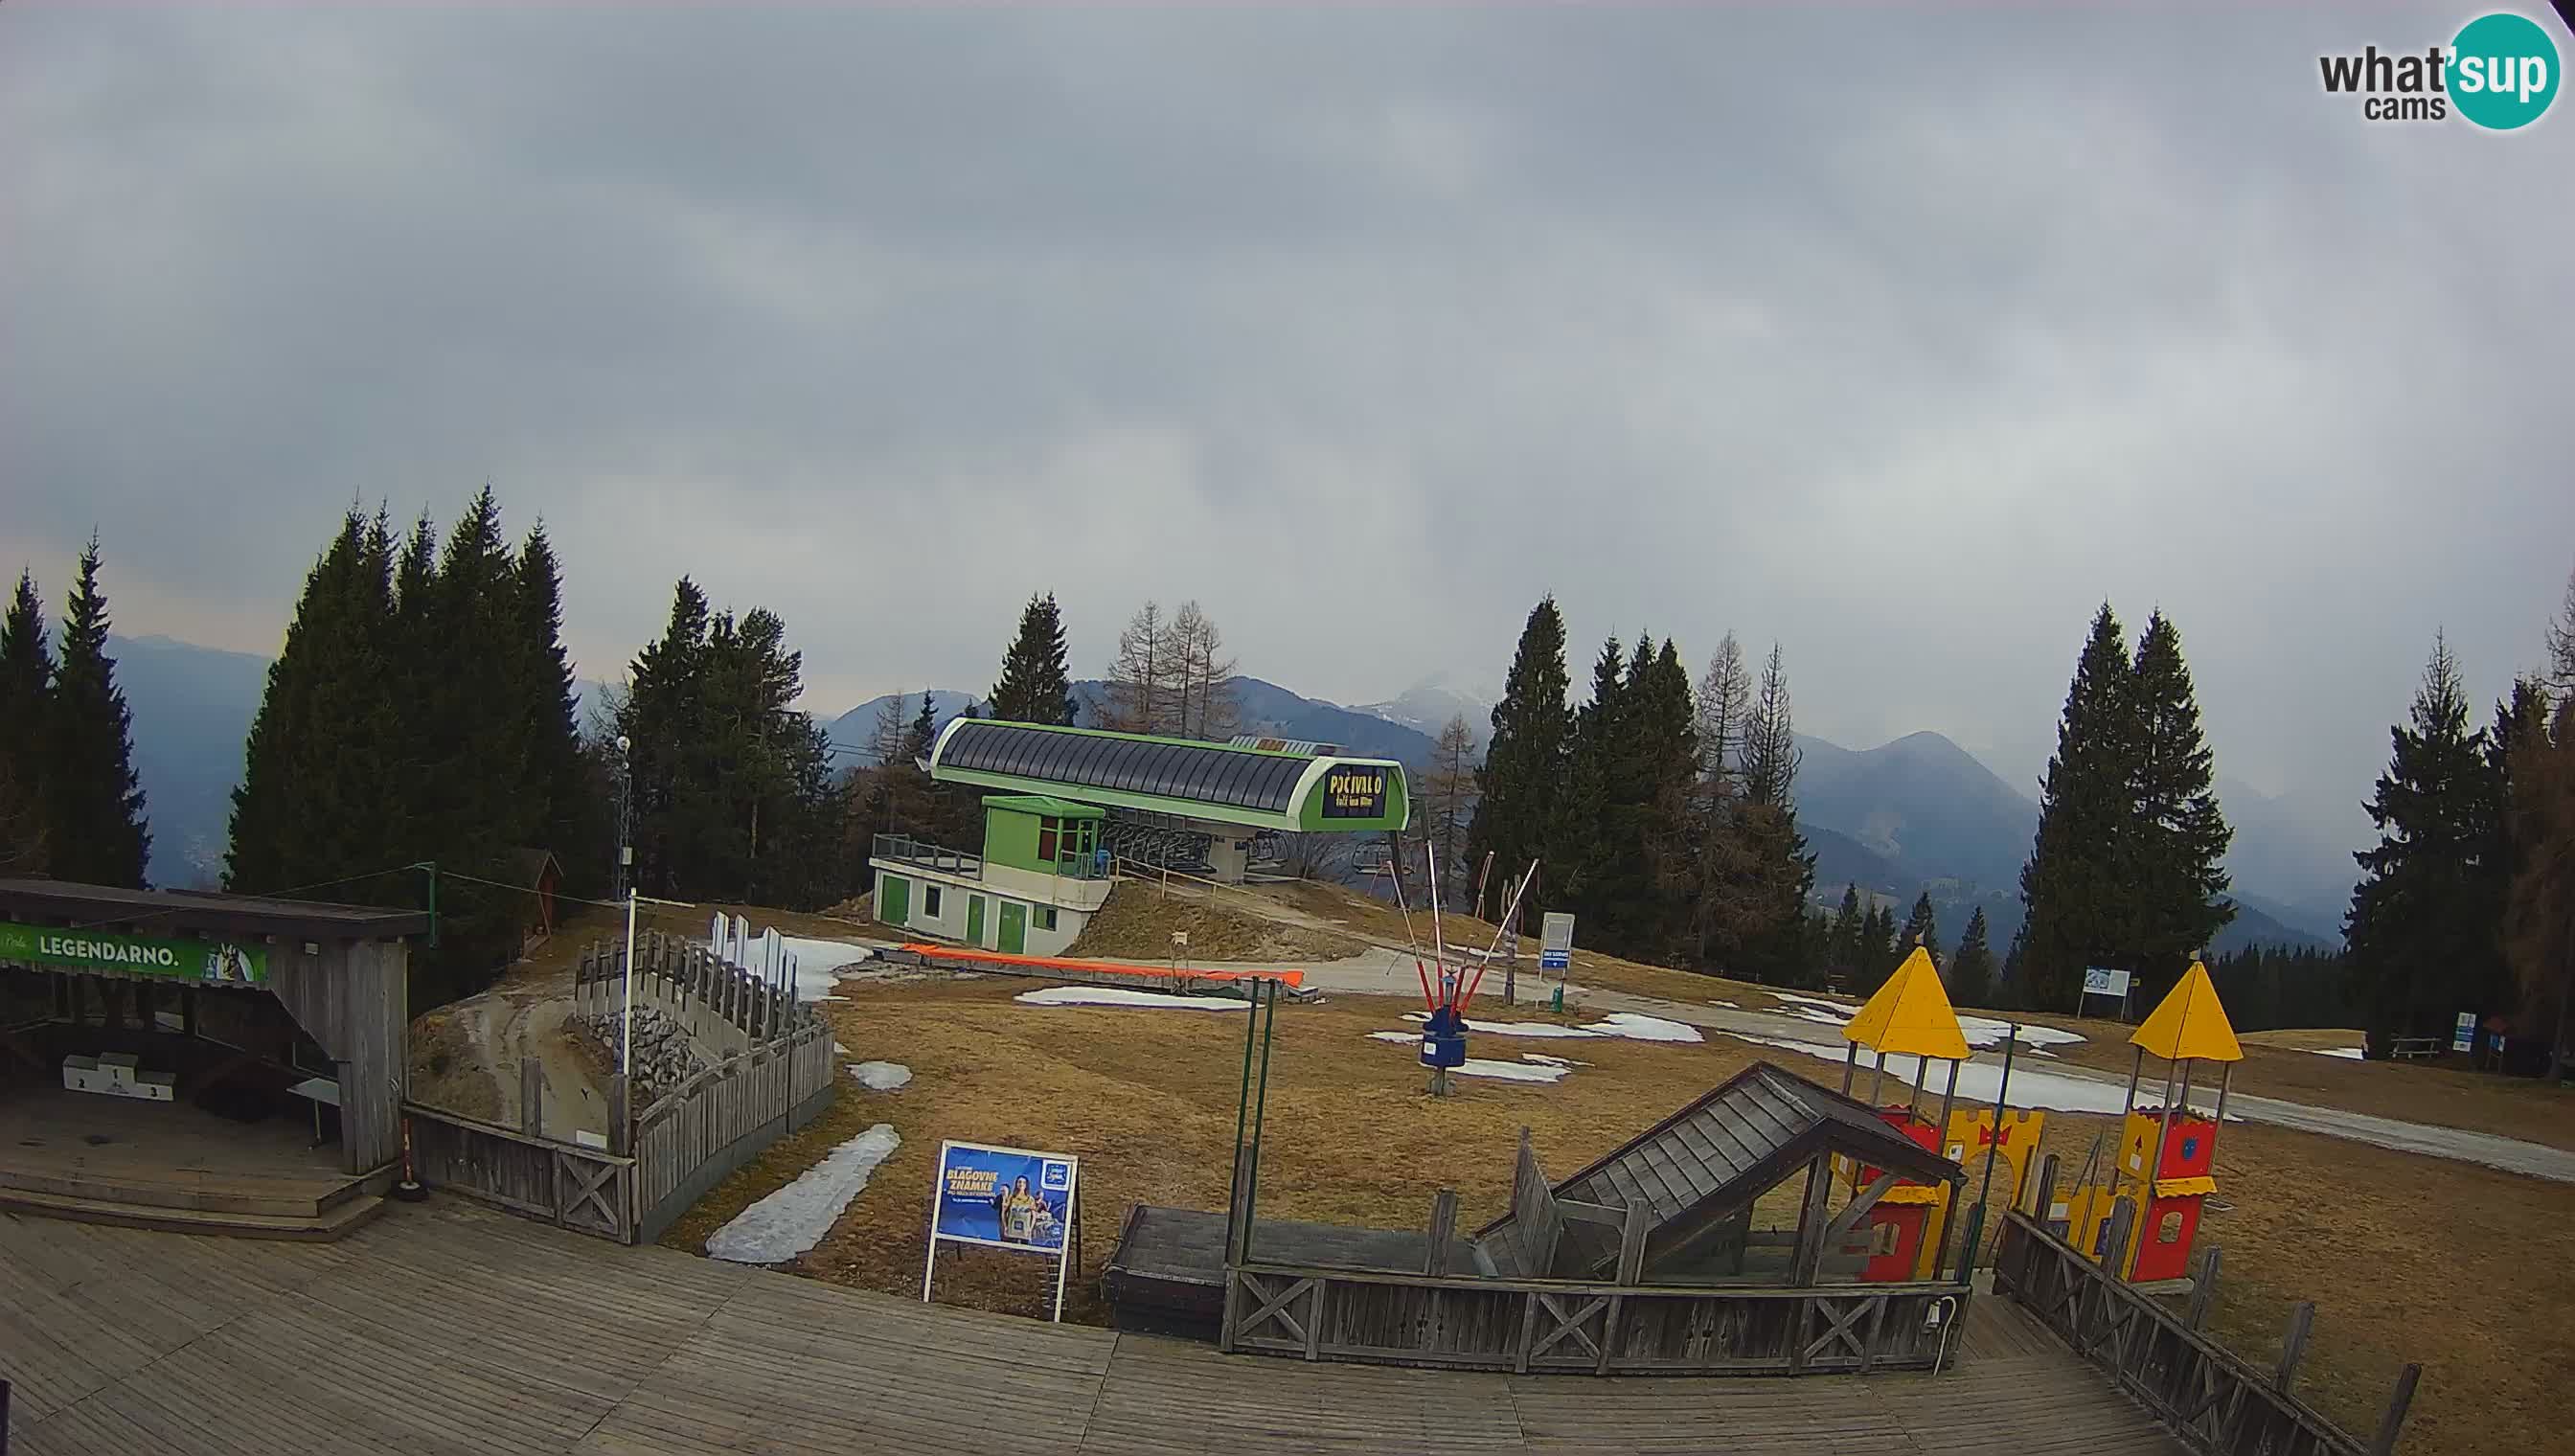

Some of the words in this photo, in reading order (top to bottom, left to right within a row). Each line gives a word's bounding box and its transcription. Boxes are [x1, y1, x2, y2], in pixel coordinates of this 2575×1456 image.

[39, 935, 180, 967] LEGENDARNO.
[150, 1086, 158, 1097] 3
[946, 1169, 999, 1183] BLAGOVNE
[949, 1179, 994, 1192] ZNAMKE
